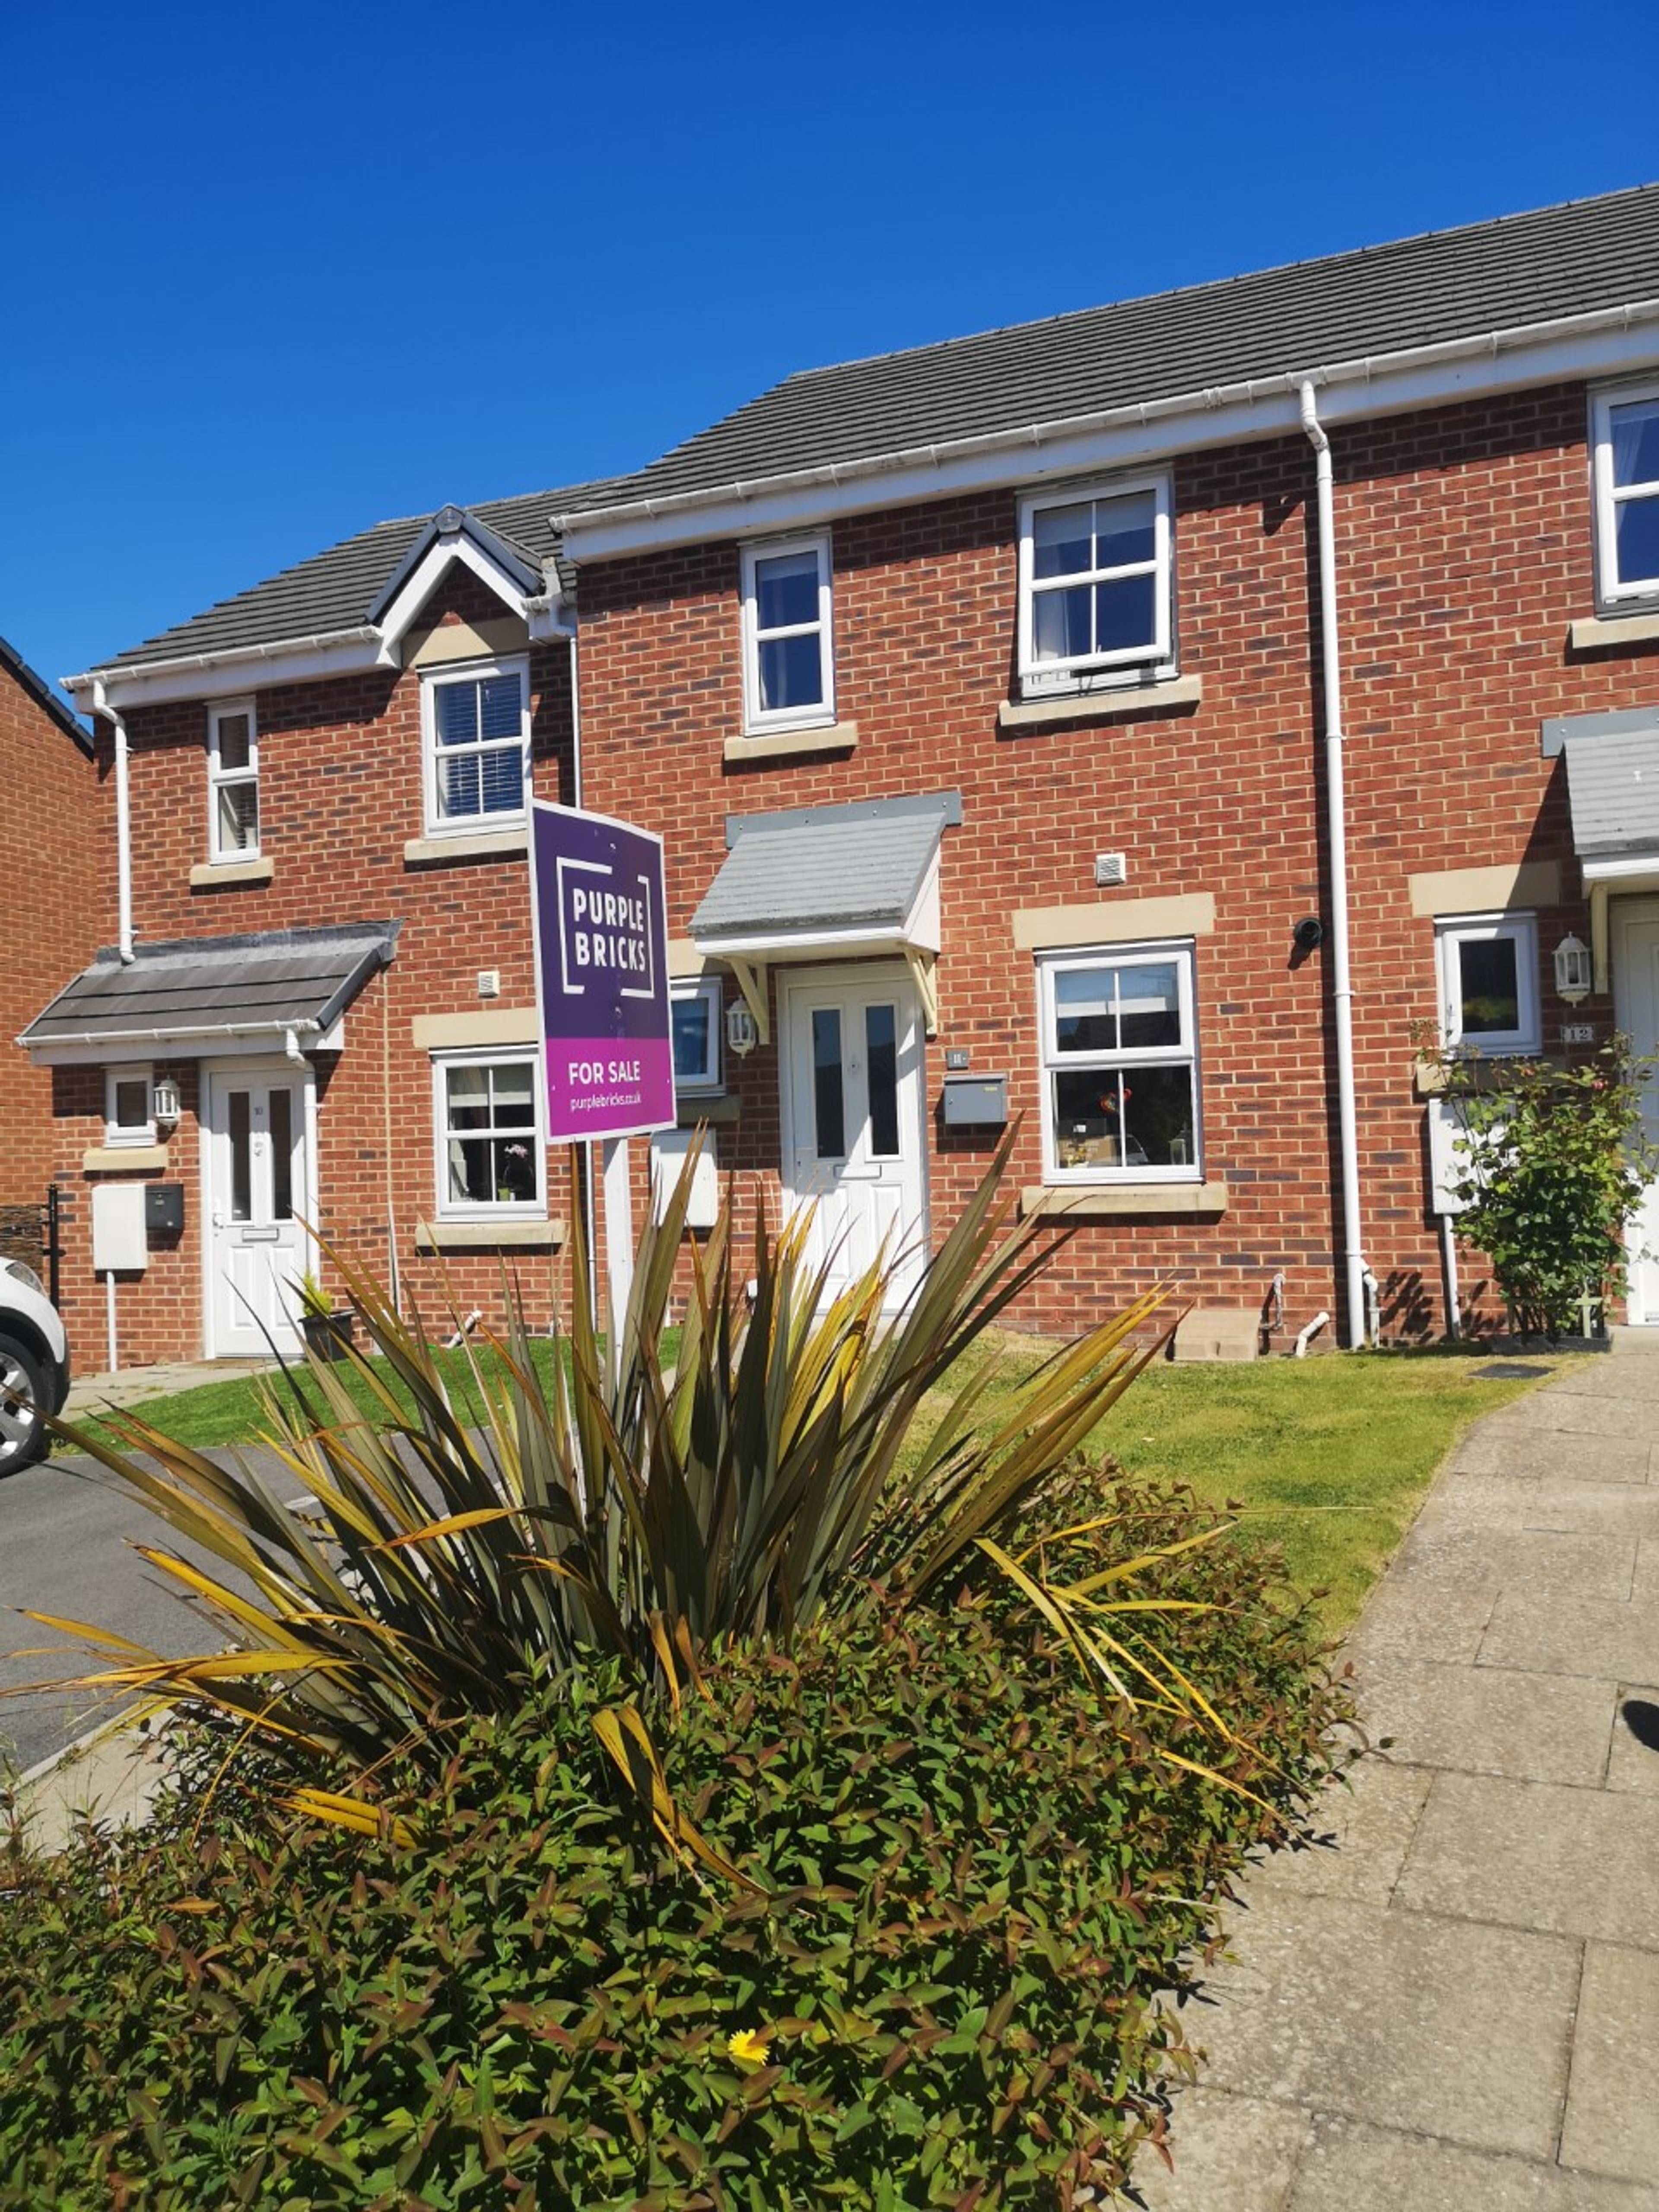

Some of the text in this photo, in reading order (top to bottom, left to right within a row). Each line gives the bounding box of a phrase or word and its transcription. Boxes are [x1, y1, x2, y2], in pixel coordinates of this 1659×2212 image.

[573, 888, 644, 932] PURPLE
[575, 931, 645, 972] BRICKS
[1571, 1029, 1588, 1039] 12
[569, 1061, 641, 1085] FOR SALE
[570, 1091, 641, 1112] purplebricks.co.uk
